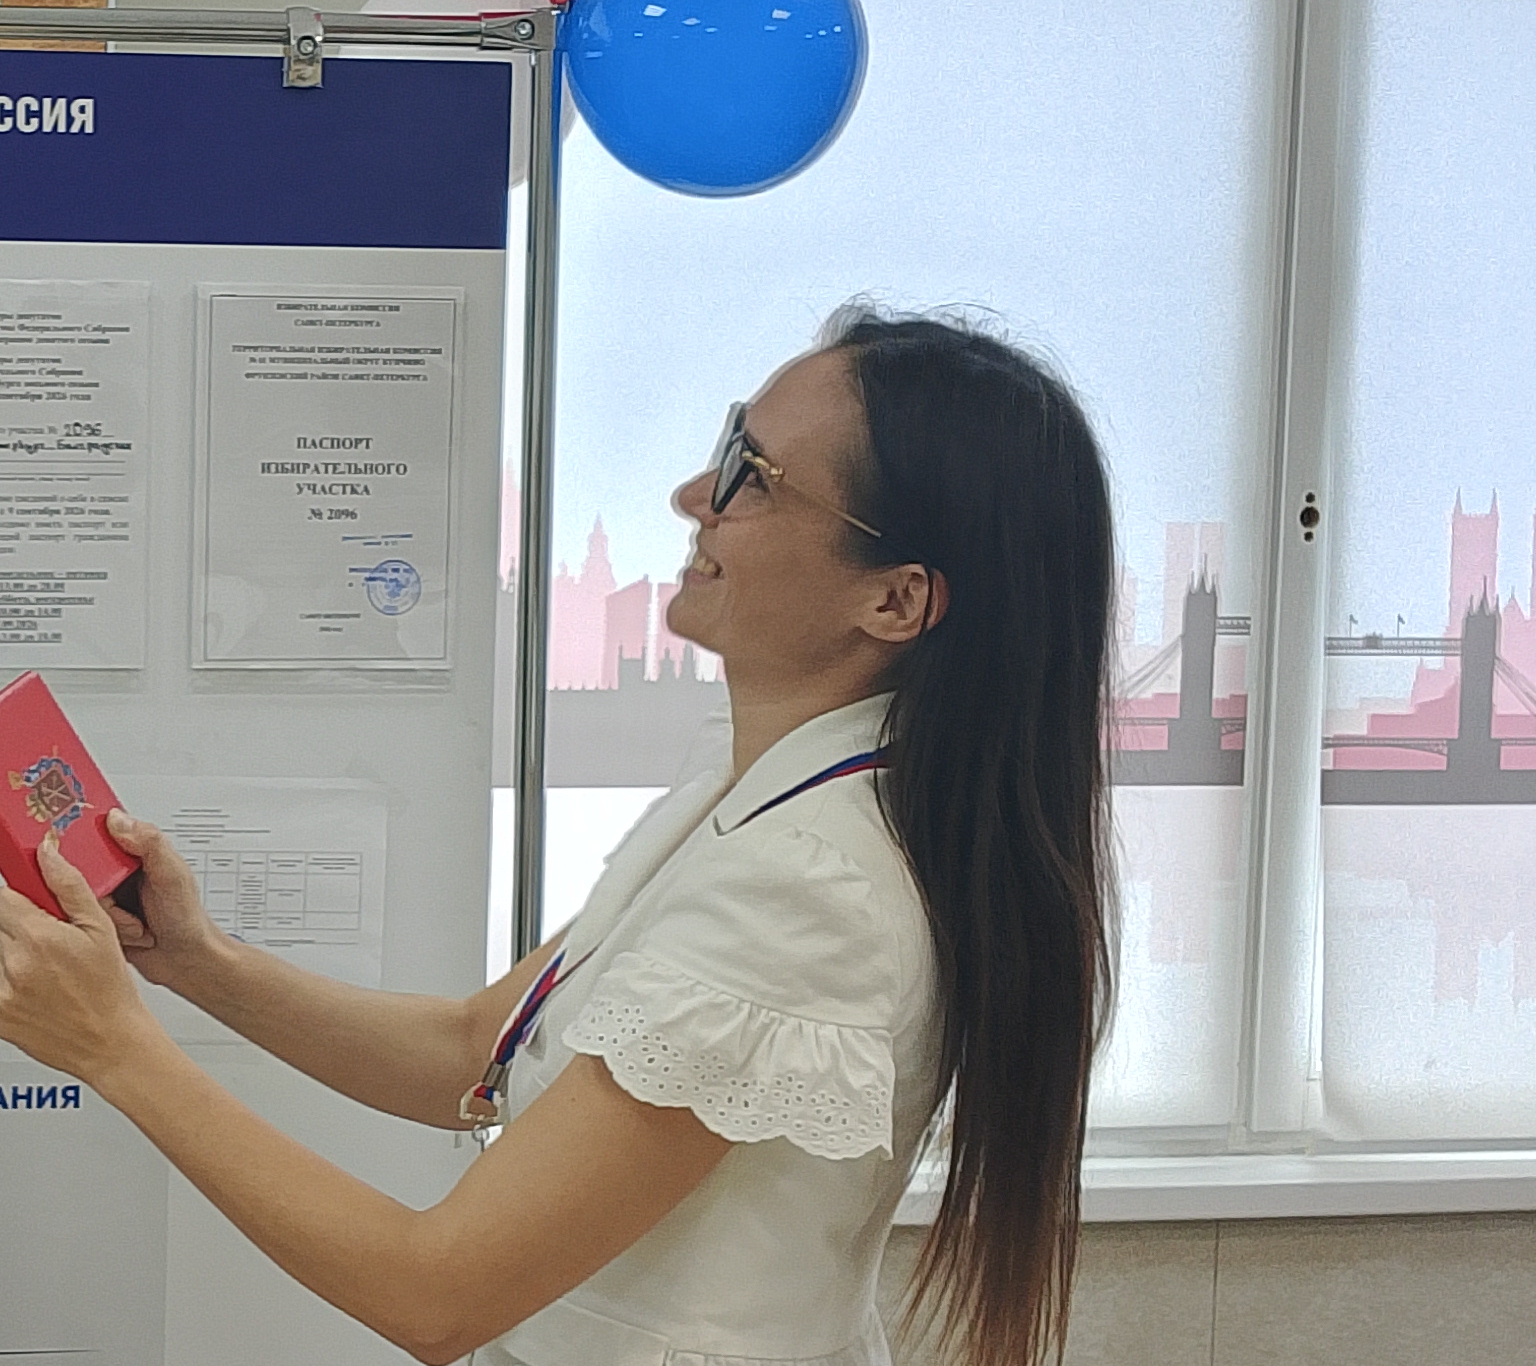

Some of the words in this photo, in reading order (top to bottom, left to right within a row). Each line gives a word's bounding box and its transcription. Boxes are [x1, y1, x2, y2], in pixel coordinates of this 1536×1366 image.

[295, 436, 374, 450] ПАСПОРТ
[260, 461, 409, 475] ИЗБИРАТЕЛЬНОГО
[295, 482, 372, 495] УЧАСТКА
